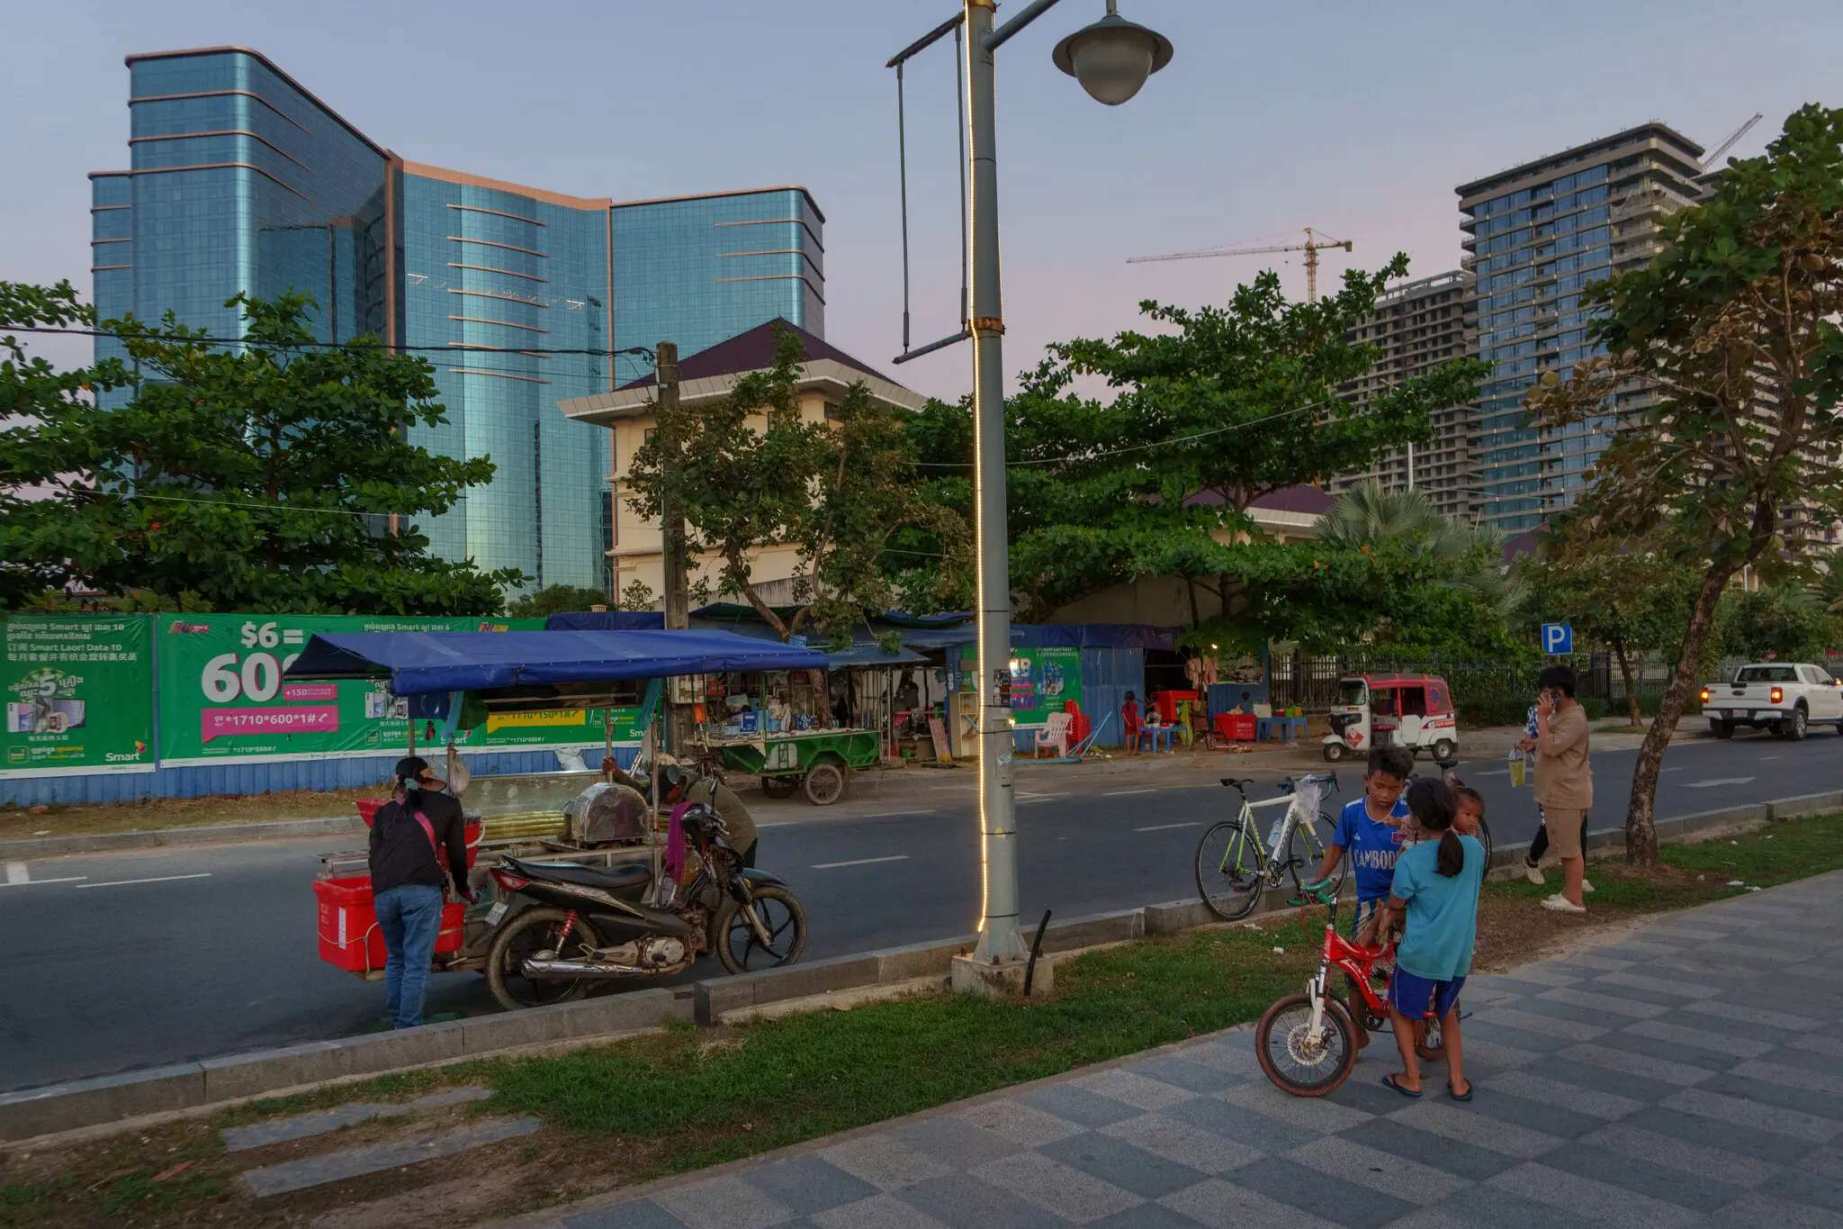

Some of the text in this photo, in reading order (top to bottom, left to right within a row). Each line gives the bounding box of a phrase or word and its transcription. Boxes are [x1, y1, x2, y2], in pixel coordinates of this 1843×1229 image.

[30, 644, 58, 652] Smart
[86, 644, 108, 652] Data
[1548, 626, 1566, 652] P
[201, 652, 300, 703] 60
[105, 752, 140, 762] Smart
[1355, 849, 1395, 869] CAMBOD
